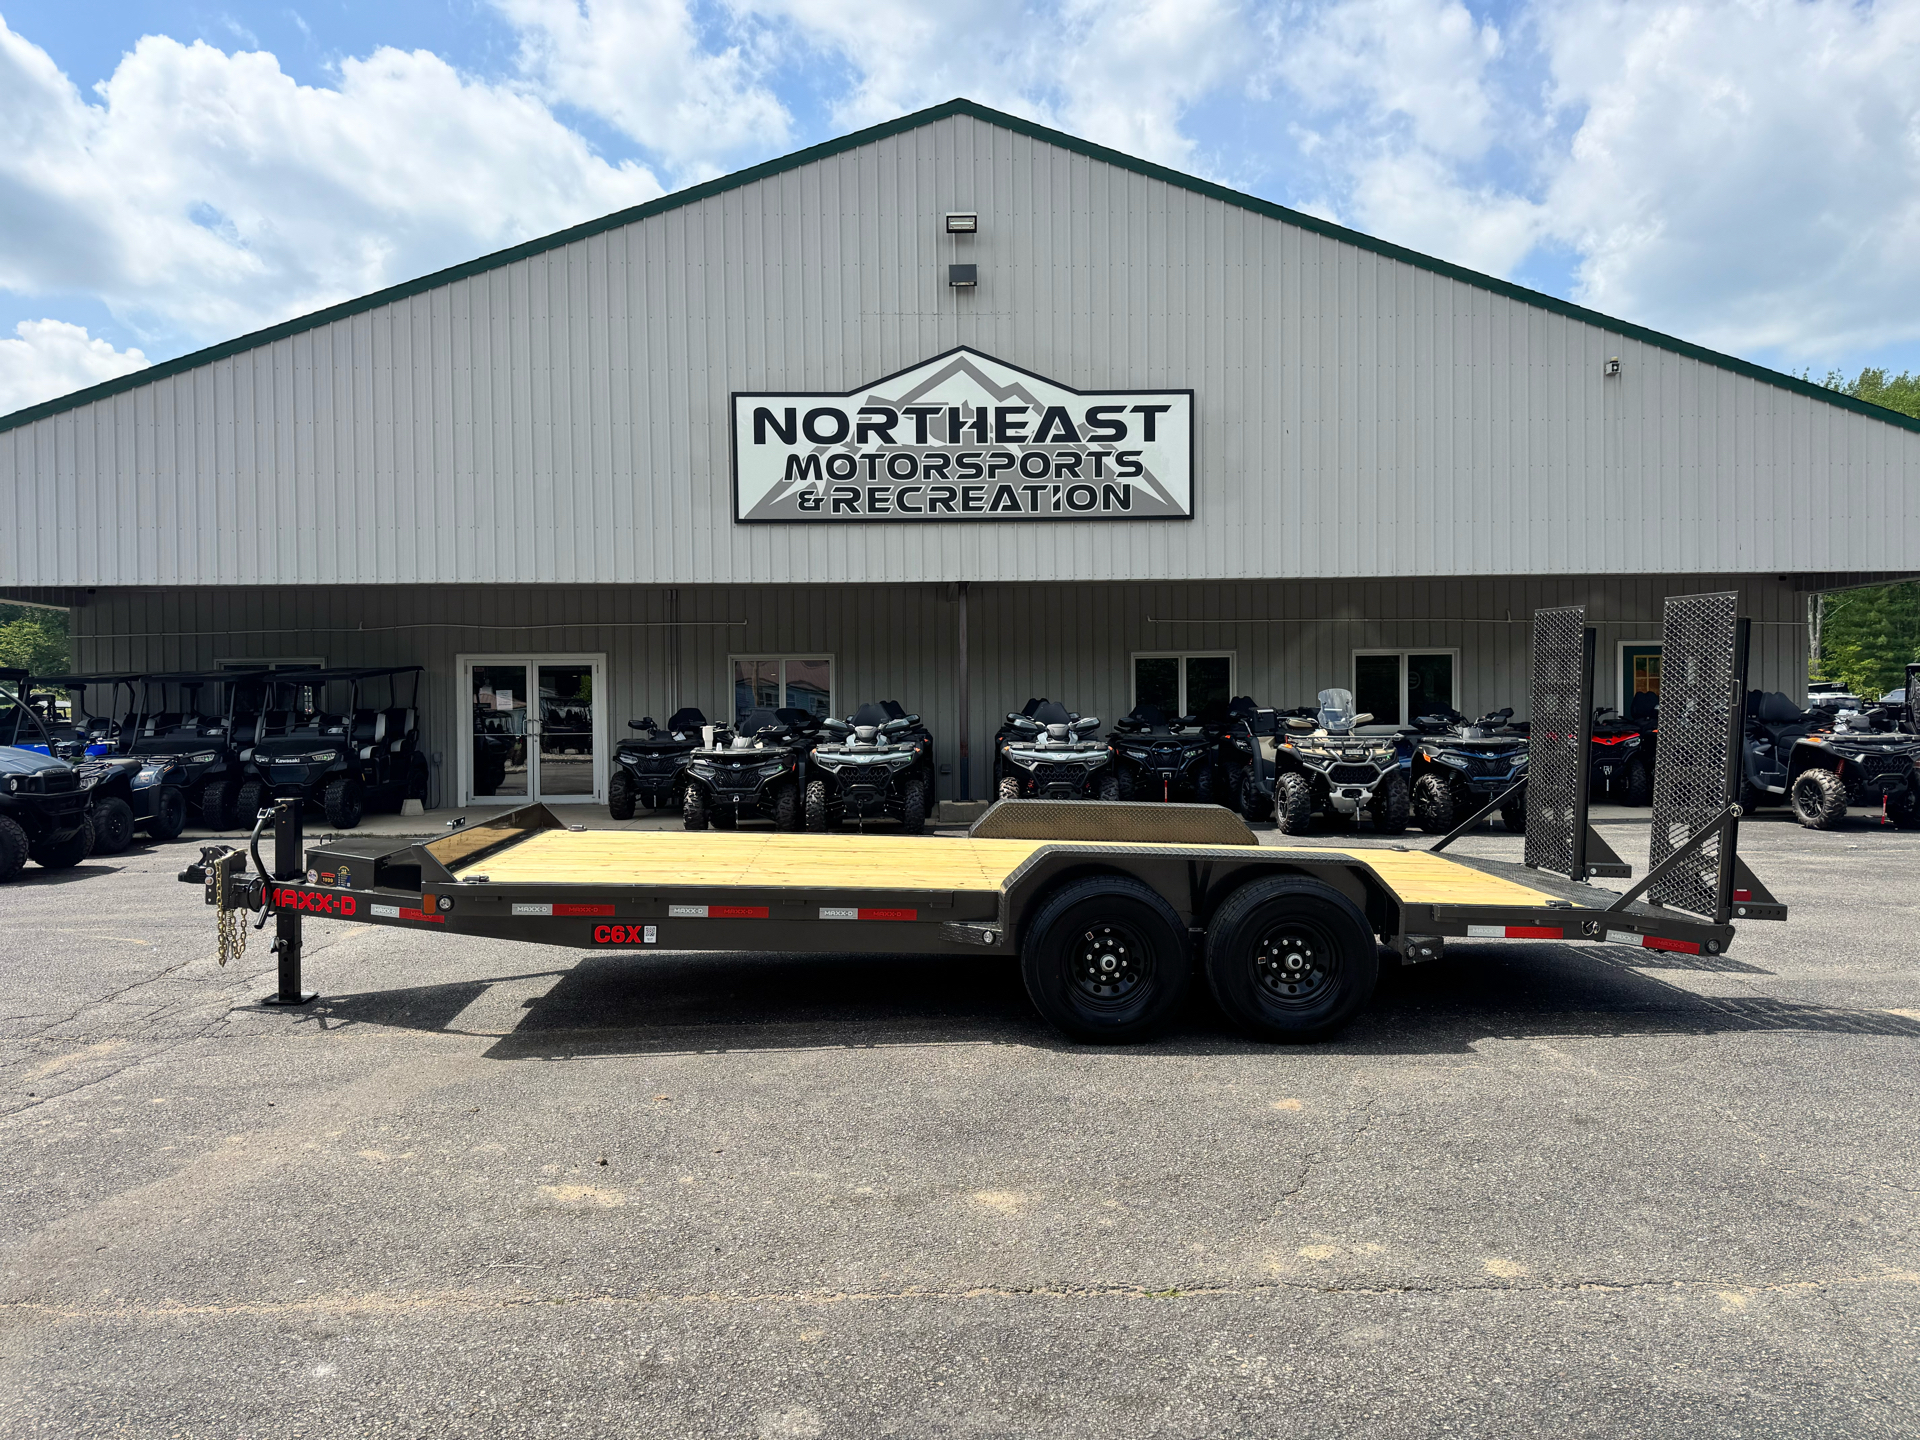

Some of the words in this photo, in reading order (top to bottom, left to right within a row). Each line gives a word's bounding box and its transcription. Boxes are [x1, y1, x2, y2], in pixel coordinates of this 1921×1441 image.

[753, 405, 1172, 445] NORTHEAST
[784, 450, 1144, 481] MOTORSPORTS
[832, 483, 1131, 513] RECREATION
[594, 925, 642, 943] C6X
[1611, 933, 1639, 942] MAXX-D
